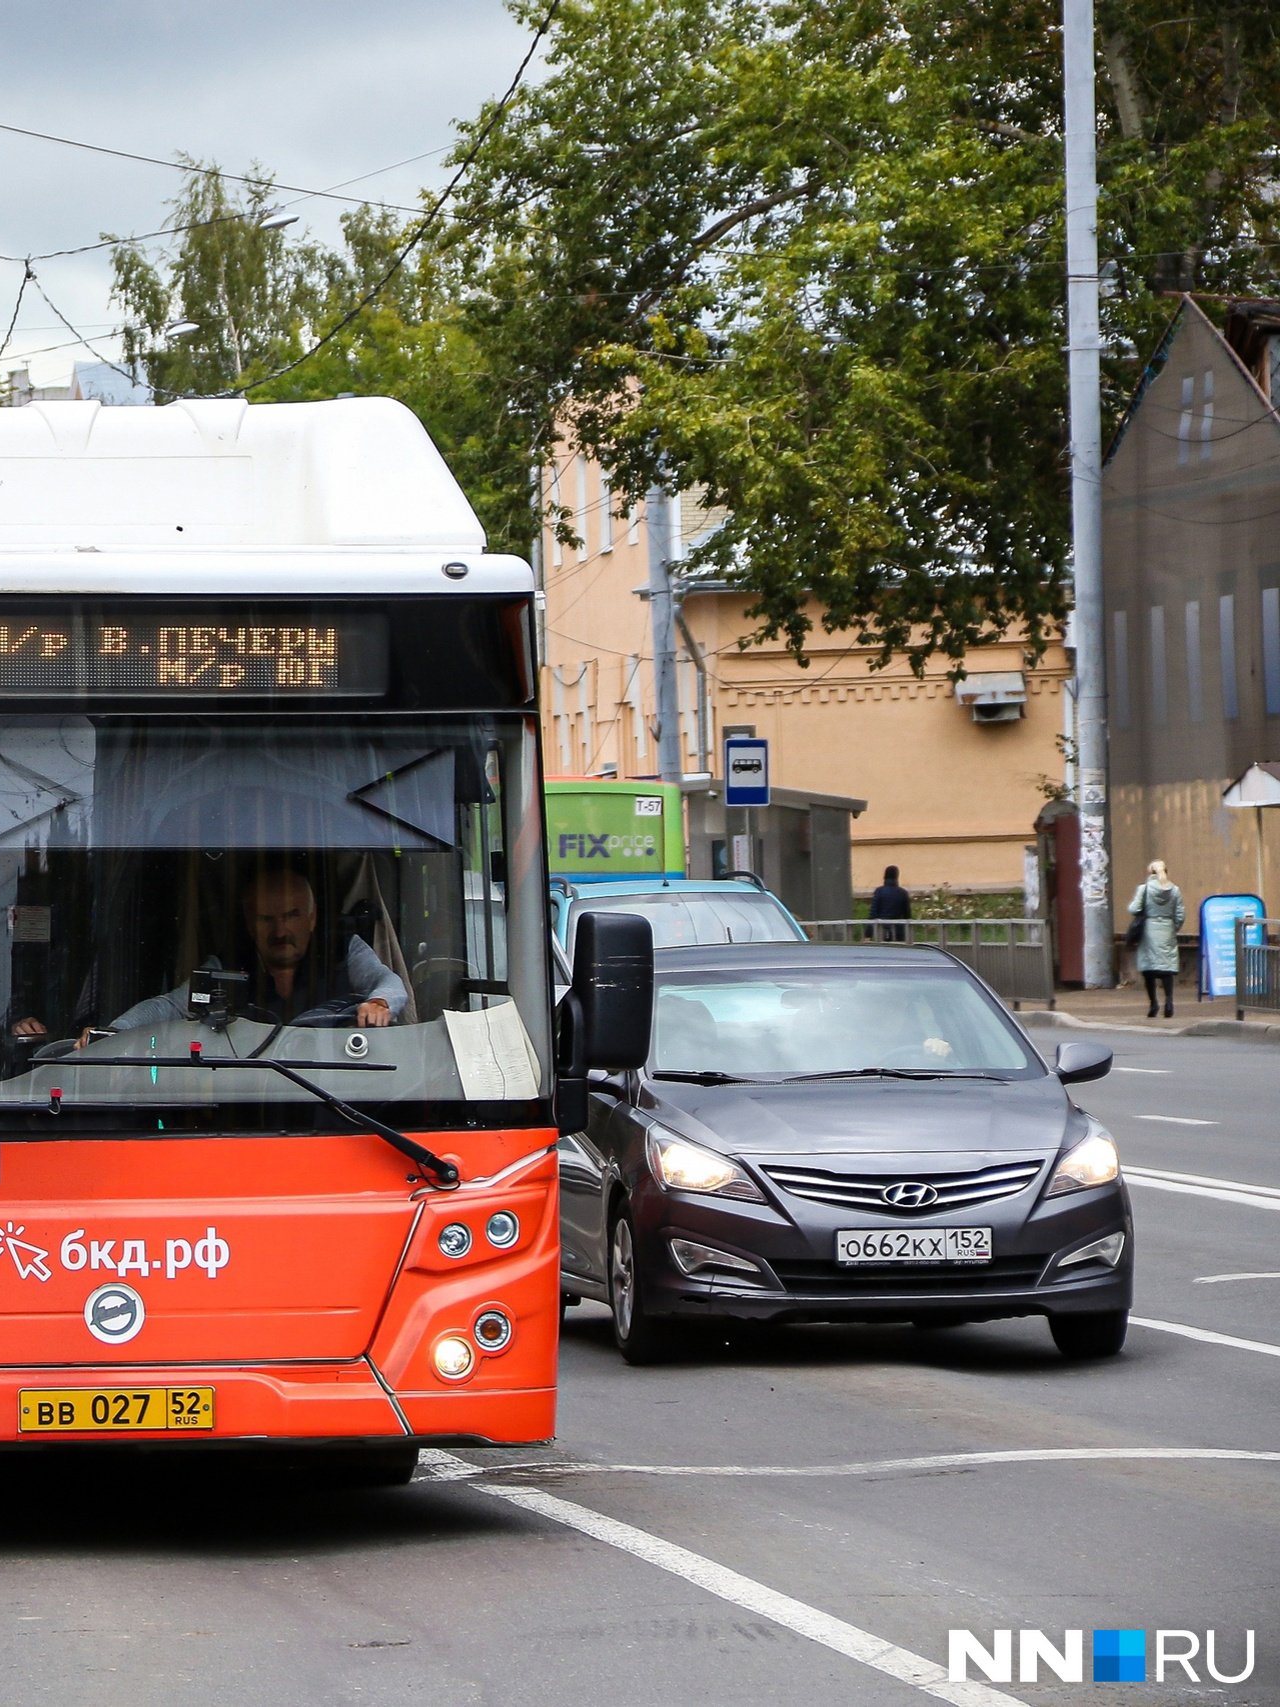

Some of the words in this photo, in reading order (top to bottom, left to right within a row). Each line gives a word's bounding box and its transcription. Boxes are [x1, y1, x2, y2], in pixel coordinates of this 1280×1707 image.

[276, 657, 336, 686] ЮГ
[949, 1230, 986, 1249] 152
[60, 1226, 231, 1279] бкд.рф
[957, 1248, 976, 1257] RUS
[37, 1401, 76, 1426] ВВ
[91, 1394, 151, 1425] 027
[171, 1391, 201, 1415] 52
[174, 1416, 199, 1426] RUS
